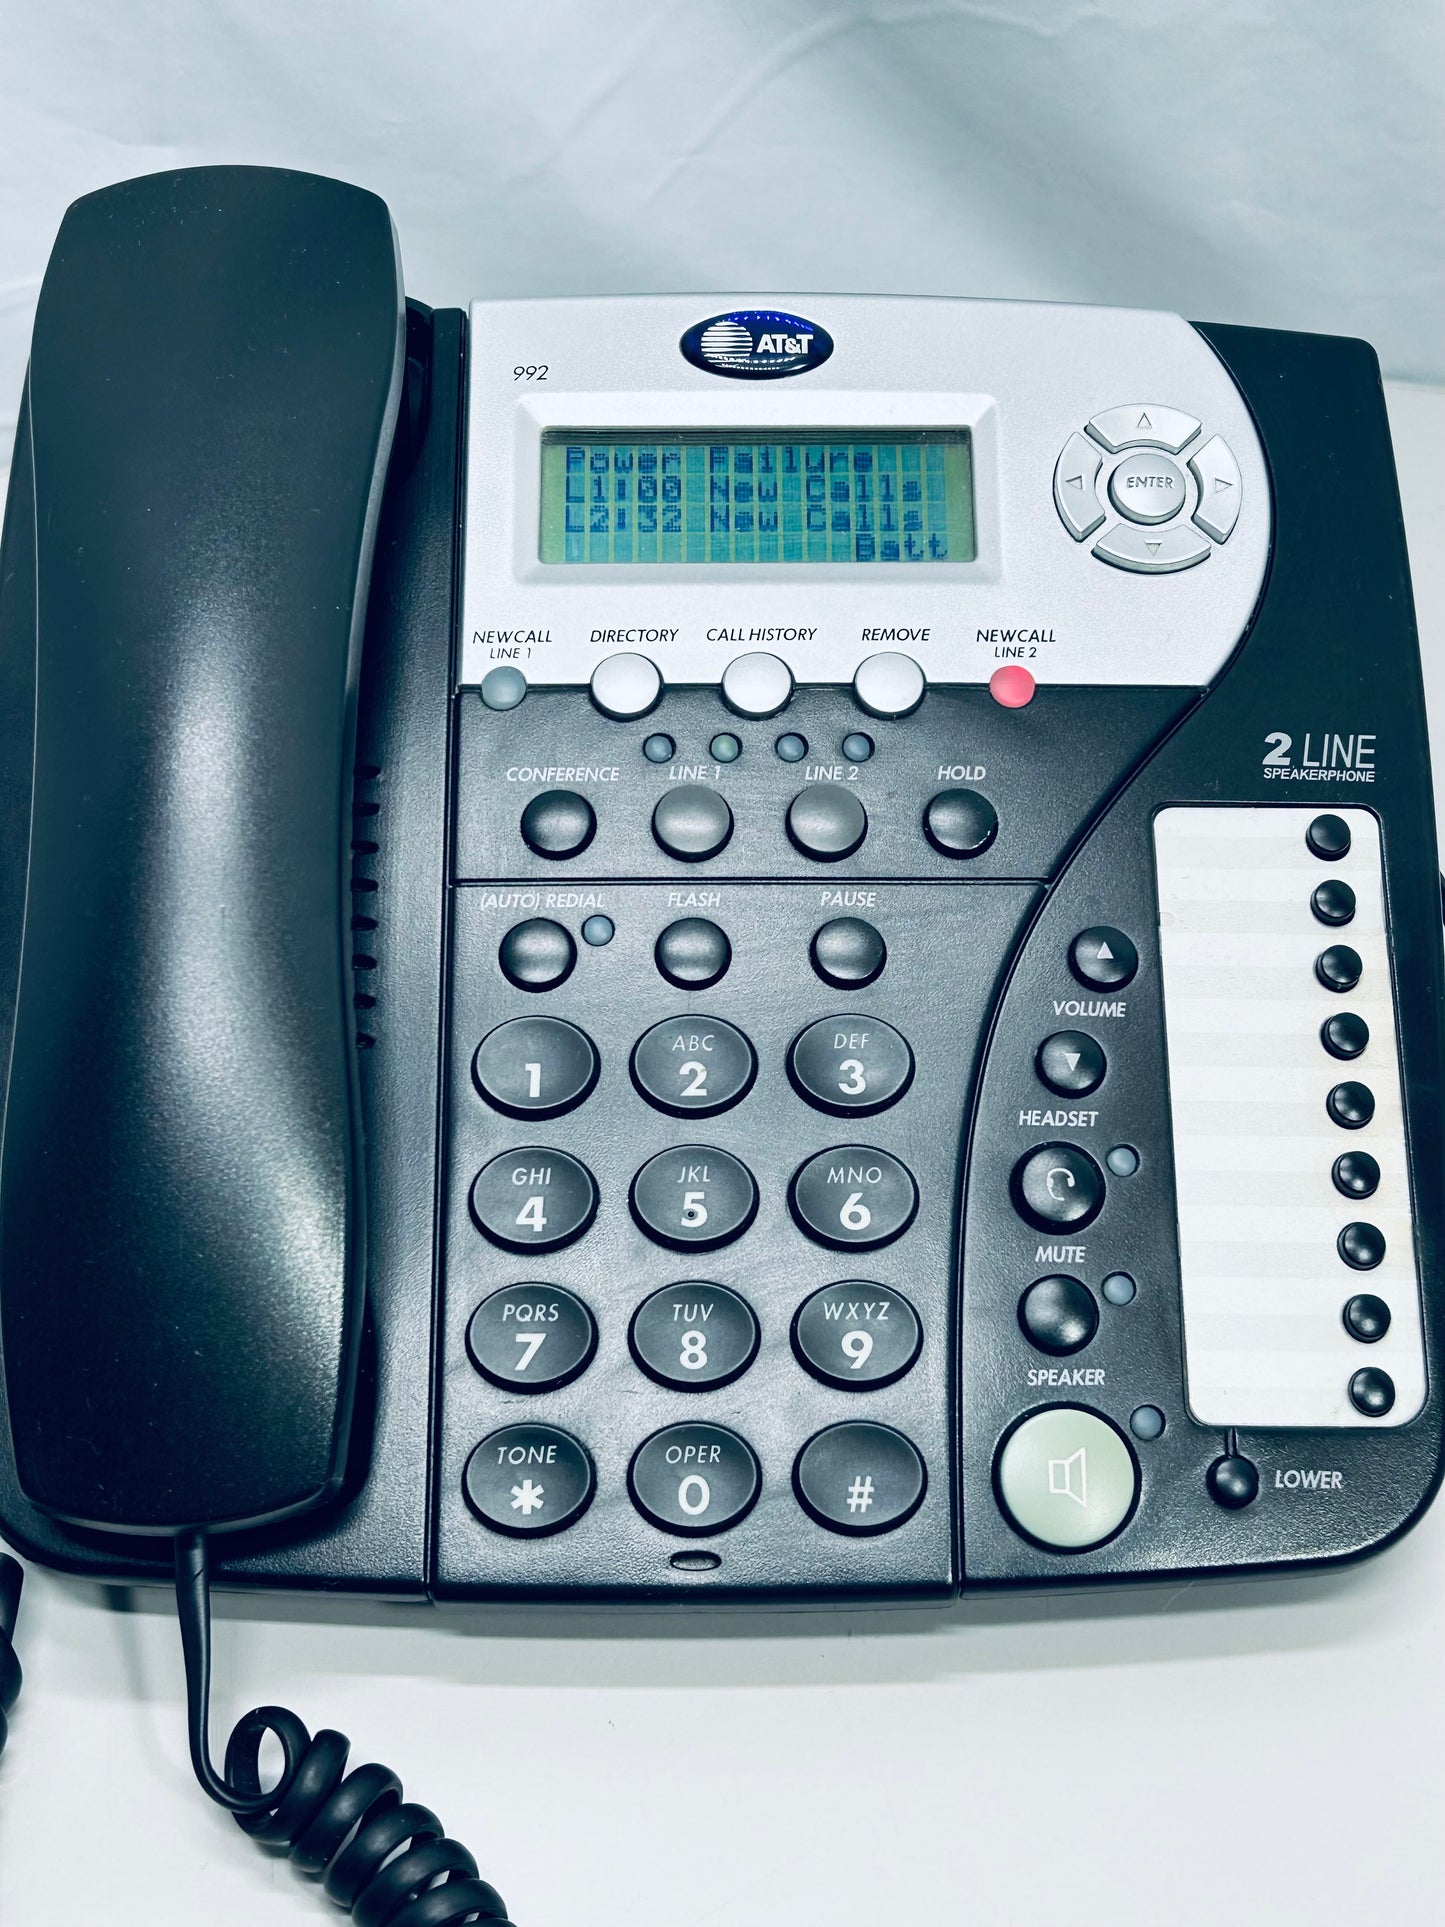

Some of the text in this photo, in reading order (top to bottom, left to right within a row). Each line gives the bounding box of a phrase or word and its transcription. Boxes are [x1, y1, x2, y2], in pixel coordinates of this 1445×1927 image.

[757, 334, 813, 354] AT&T
[512, 365, 549, 381] 992
[566, 446, 872, 474] Power Failure
[710, 475, 777, 503] New
[806, 474, 922, 502] Calls
[1126, 476, 1173, 489] ENTER
[710, 504, 778, 533] New
[807, 504, 922, 532] Calls
[856, 533, 947, 562] Batt
[590, 629, 679, 642] DIRECTORY
[706, 628, 817, 641] CALL HISTORY
[862, 628, 931, 641] REMOVE
[490, 648, 532, 659] LINE 1
[994, 646, 1037, 658] LINE 2
[1262, 732, 1376, 769] 2 LINE
[506, 767, 620, 782] CONFERENCE
[669, 765, 721, 780] LINE 1
[805, 765, 859, 780] LINE 2
[937, 765, 986, 781] HOLD
[1263, 768, 1376, 783] SPEAKERPHONE
[480, 892, 605, 910] (AUTO) REDIAL
[667, 892, 721, 908] FLASH
[821, 891, 877, 908] PAUSE
[1053, 1001, 1126, 1018] VOLUME
[672, 1035, 714, 1053] ABC
[834, 1033, 869, 1050] DEF
[525, 1063, 541, 1098] 1
[679, 1061, 708, 1097] 2
[838, 1059, 866, 1096] 3
[1019, 1110, 1098, 1128] HEADSET
[512, 1167, 551, 1186] GHI
[677, 1165, 711, 1184] JKL
[827, 1166, 882, 1185] MNO
[516, 1197, 547, 1232] 4
[681, 1192, 708, 1228] 5
[840, 1192, 871, 1230] 6
[1035, 1246, 1086, 1264] MUTE
[502, 1304, 560, 1323] PQRS
[673, 1303, 714, 1322] TUV
[824, 1302, 890, 1321] WXYZ
[515, 1333, 546, 1371] 7
[680, 1330, 708, 1370] 8
[841, 1330, 874, 1369] 9
[1027, 1368, 1105, 1386] SPEAKER
[497, 1446, 557, 1465] TONE
[665, 1445, 721, 1464] OPER
[1275, 1470, 1342, 1489] LOWER
[678, 1475, 710, 1515] 0
[847, 1475, 874, 1513] #
